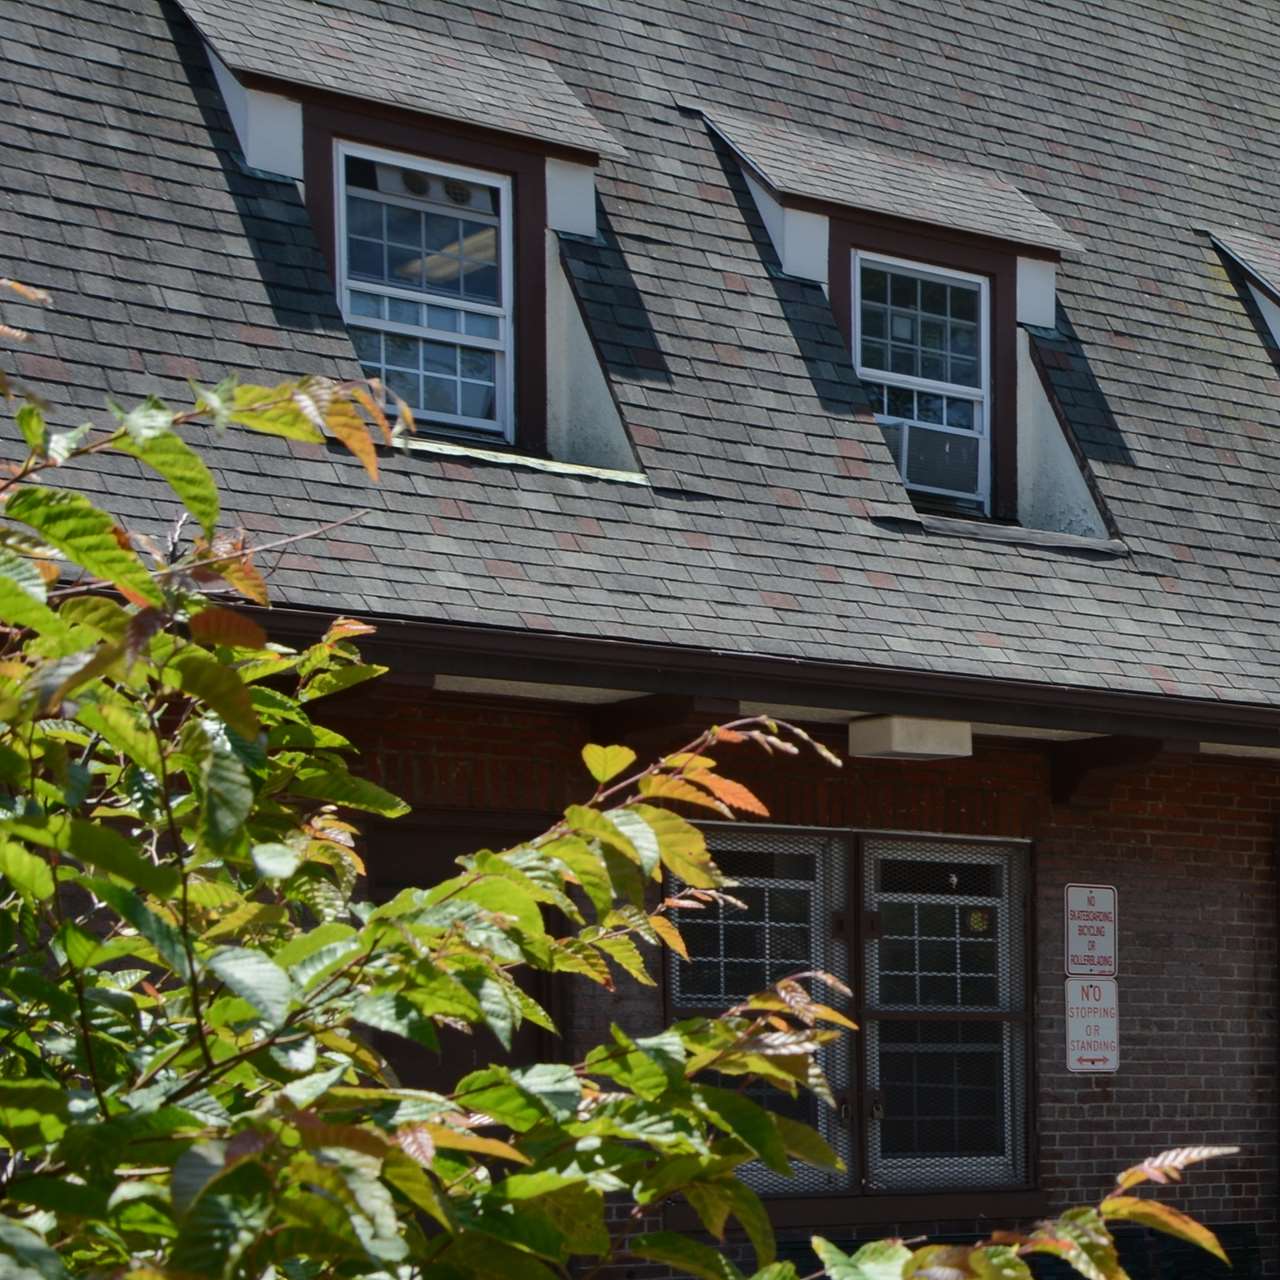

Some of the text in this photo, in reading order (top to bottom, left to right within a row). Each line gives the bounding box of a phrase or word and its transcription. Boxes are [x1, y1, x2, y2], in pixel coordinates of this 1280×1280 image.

[1087, 895, 1096, 907] NO
[1087, 940, 1096, 951] OR
[1081, 985, 1102, 1002] NO
[1069, 1007, 1115, 1019] STOPPING
[1085, 1024, 1100, 1036] OR
[1070, 1039, 1116, 1052] STANDING
